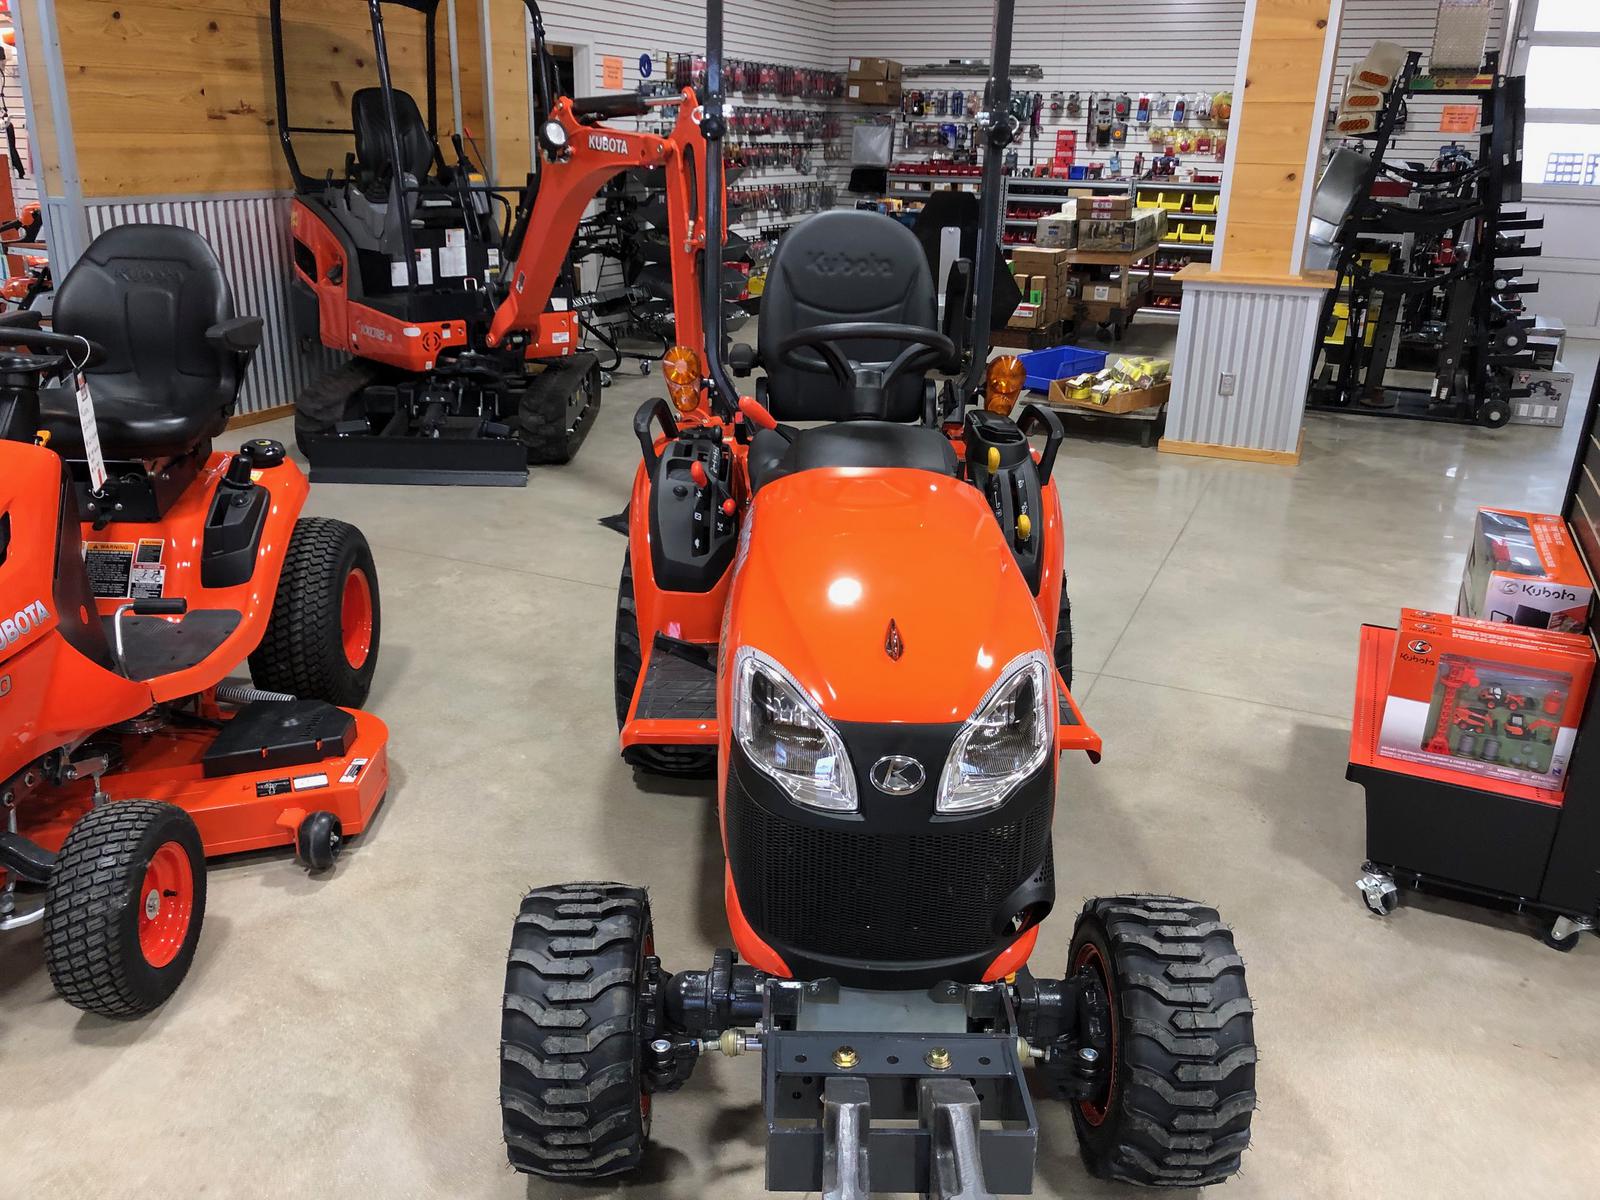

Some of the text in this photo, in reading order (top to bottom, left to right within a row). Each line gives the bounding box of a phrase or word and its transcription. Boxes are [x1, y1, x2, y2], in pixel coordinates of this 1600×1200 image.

[588, 135, 628, 154] KUBOTA
[1522, 584, 1576, 601] Kubota
[1400, 652, 1435, 666] Kubota
